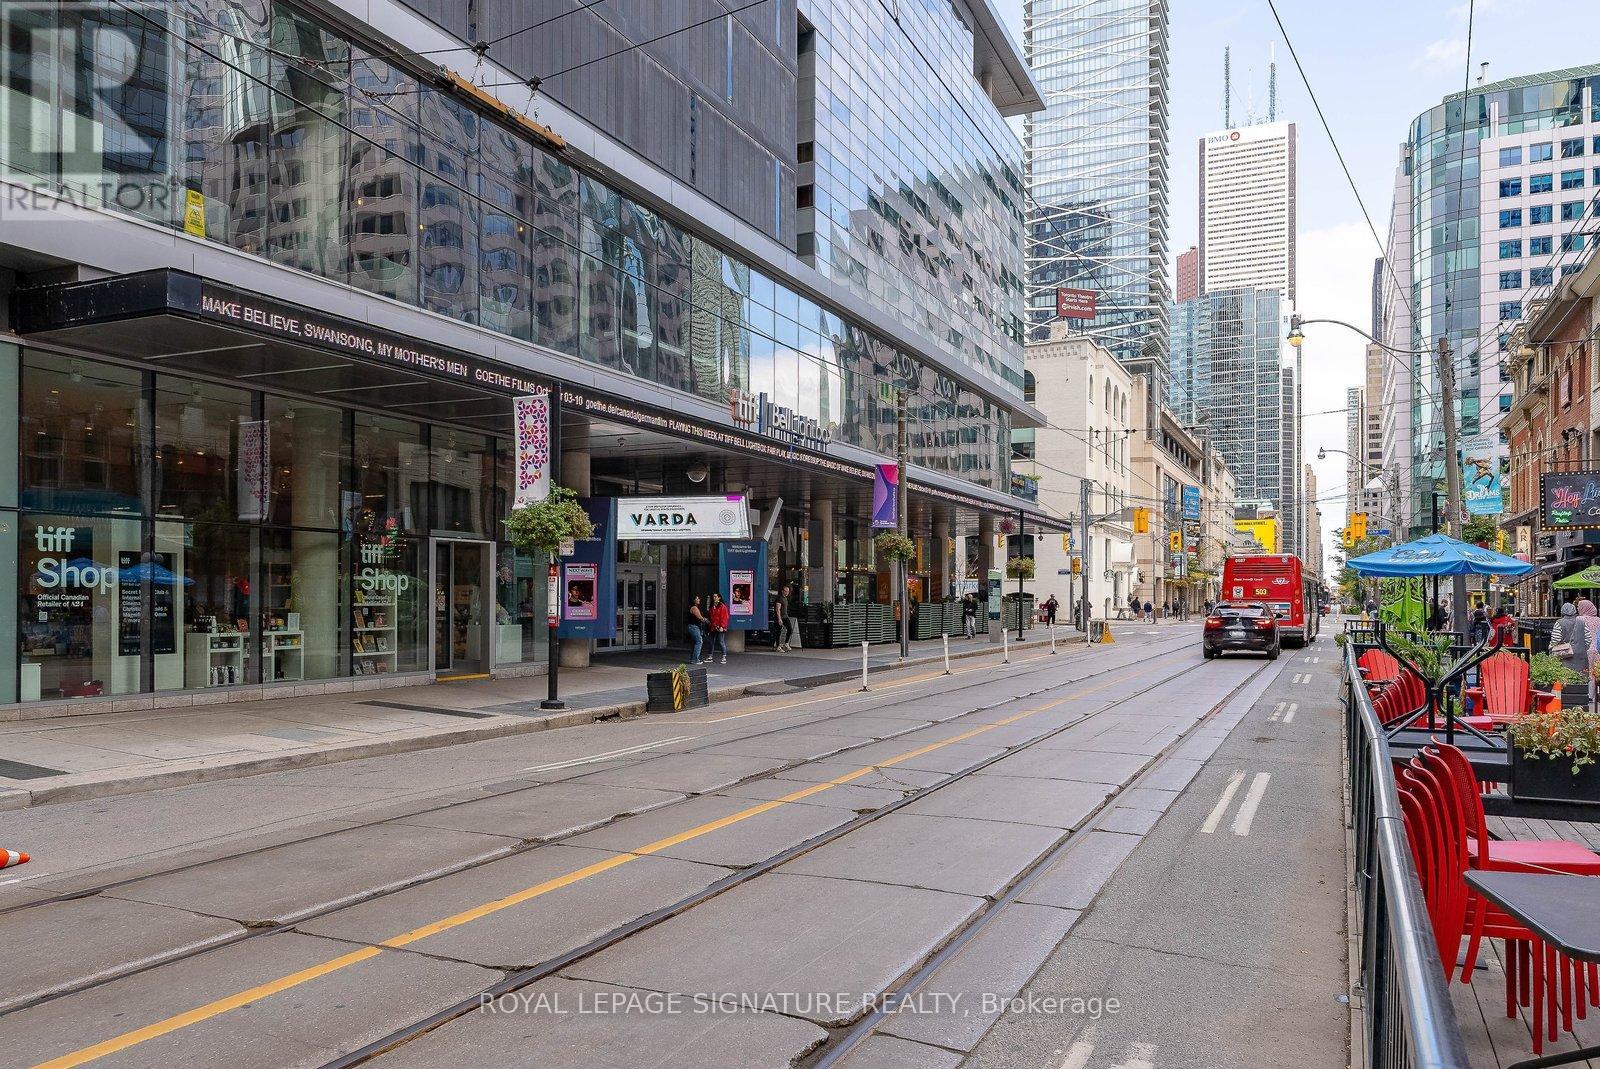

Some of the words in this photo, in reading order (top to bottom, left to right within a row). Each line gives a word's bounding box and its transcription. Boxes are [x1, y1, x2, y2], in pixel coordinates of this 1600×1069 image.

[1208, 135, 1229, 143] BMO
[202, 296, 241, 319] MAKE
[244, 307, 301, 336] BELIEVE,
[304, 323, 376, 355] SWANSONG,
[377, 342, 394, 358] MY
[394, 348, 445, 371] MOTHER'S
[446, 361, 468, 377] MEN
[475, 368, 511, 389] GOETHE
[511, 378, 535, 396] FILMS
[564, 392, 584, 406] 03-10
[668, 420, 691, 434] PLAYING
[691, 425, 703, 437] THIS
[703, 429, 718, 440] WEEK
[718, 433, 724, 441] AT
[724, 434, 734, 445] TIFF
[734, 436, 746, 448] BELL
[730, 388, 759, 424] tiff
[767, 402, 793, 432] Bell
[1466, 489, 1500, 500] DREAMS
[1551, 484, 1581, 509] Hey
[630, 512, 698, 526] VARDA
[35, 525, 75, 552] tiff
[361, 544, 384, 564] tiff
[36, 557, 118, 595] Shop
[361, 567, 409, 596] Shop
[37, 593, 60, 601] Official
